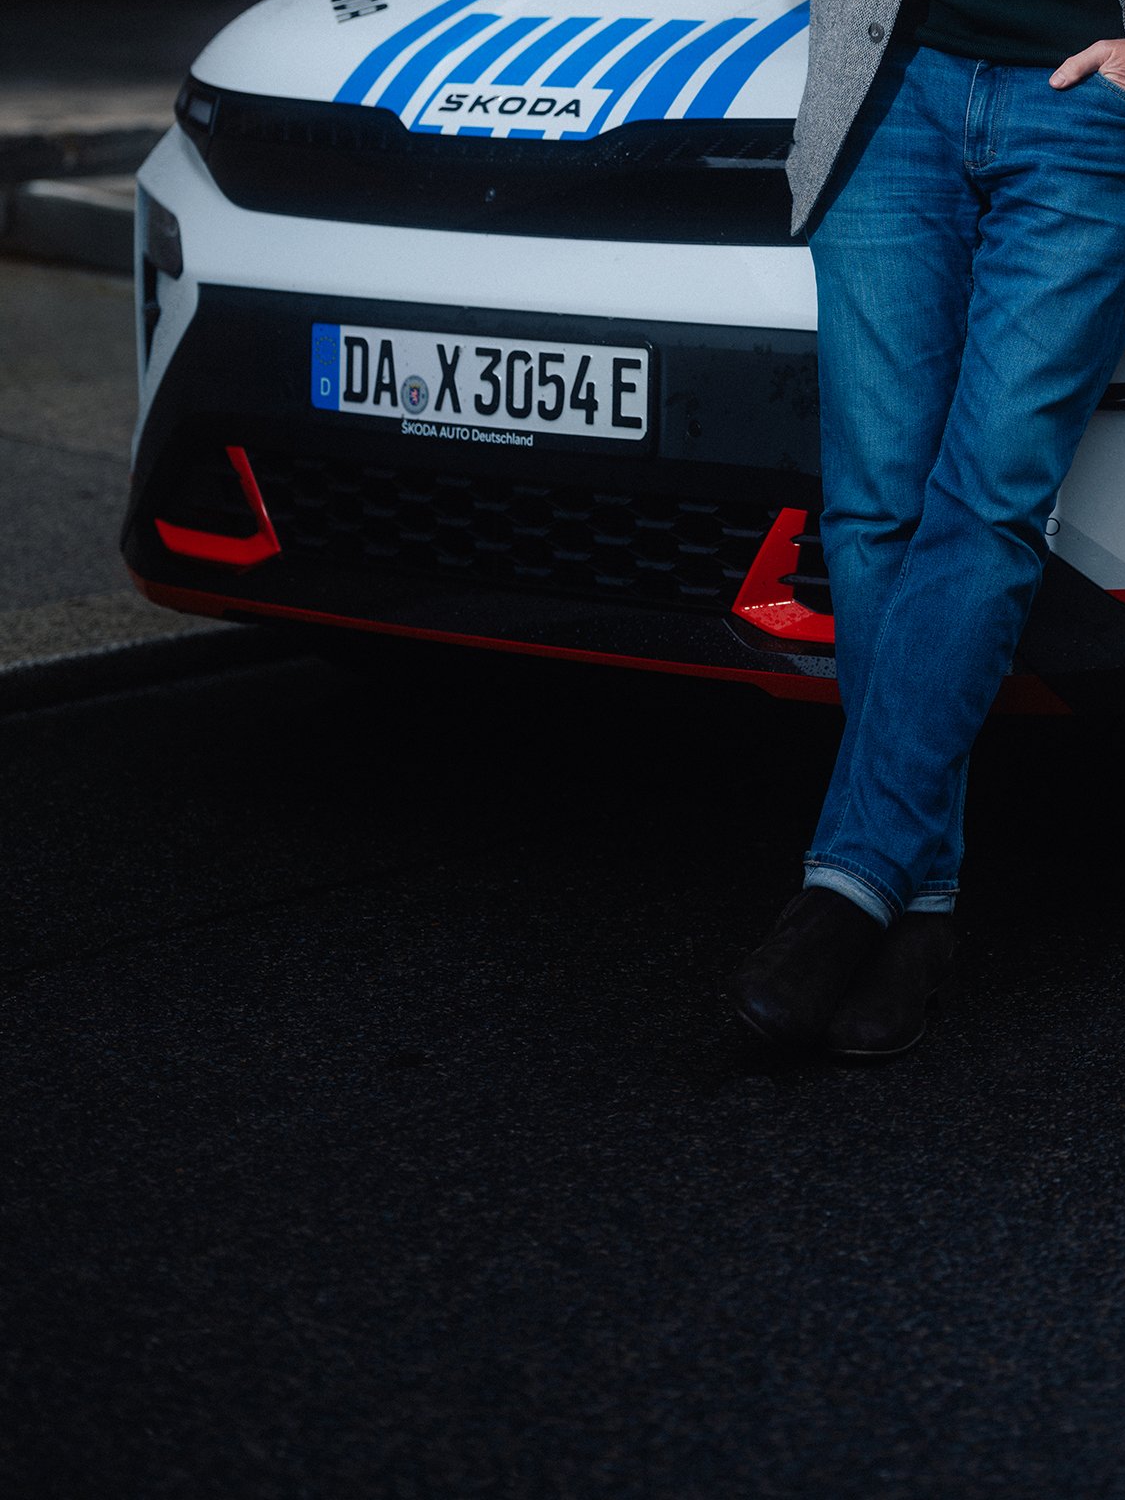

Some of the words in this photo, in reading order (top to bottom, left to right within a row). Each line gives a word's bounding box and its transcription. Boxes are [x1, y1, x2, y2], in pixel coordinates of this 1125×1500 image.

[343, 336, 399, 407] DA
[320, 377, 331, 397] D
[440, 426, 470, 441] AUTO
[471, 429, 534, 447] Deutschland
